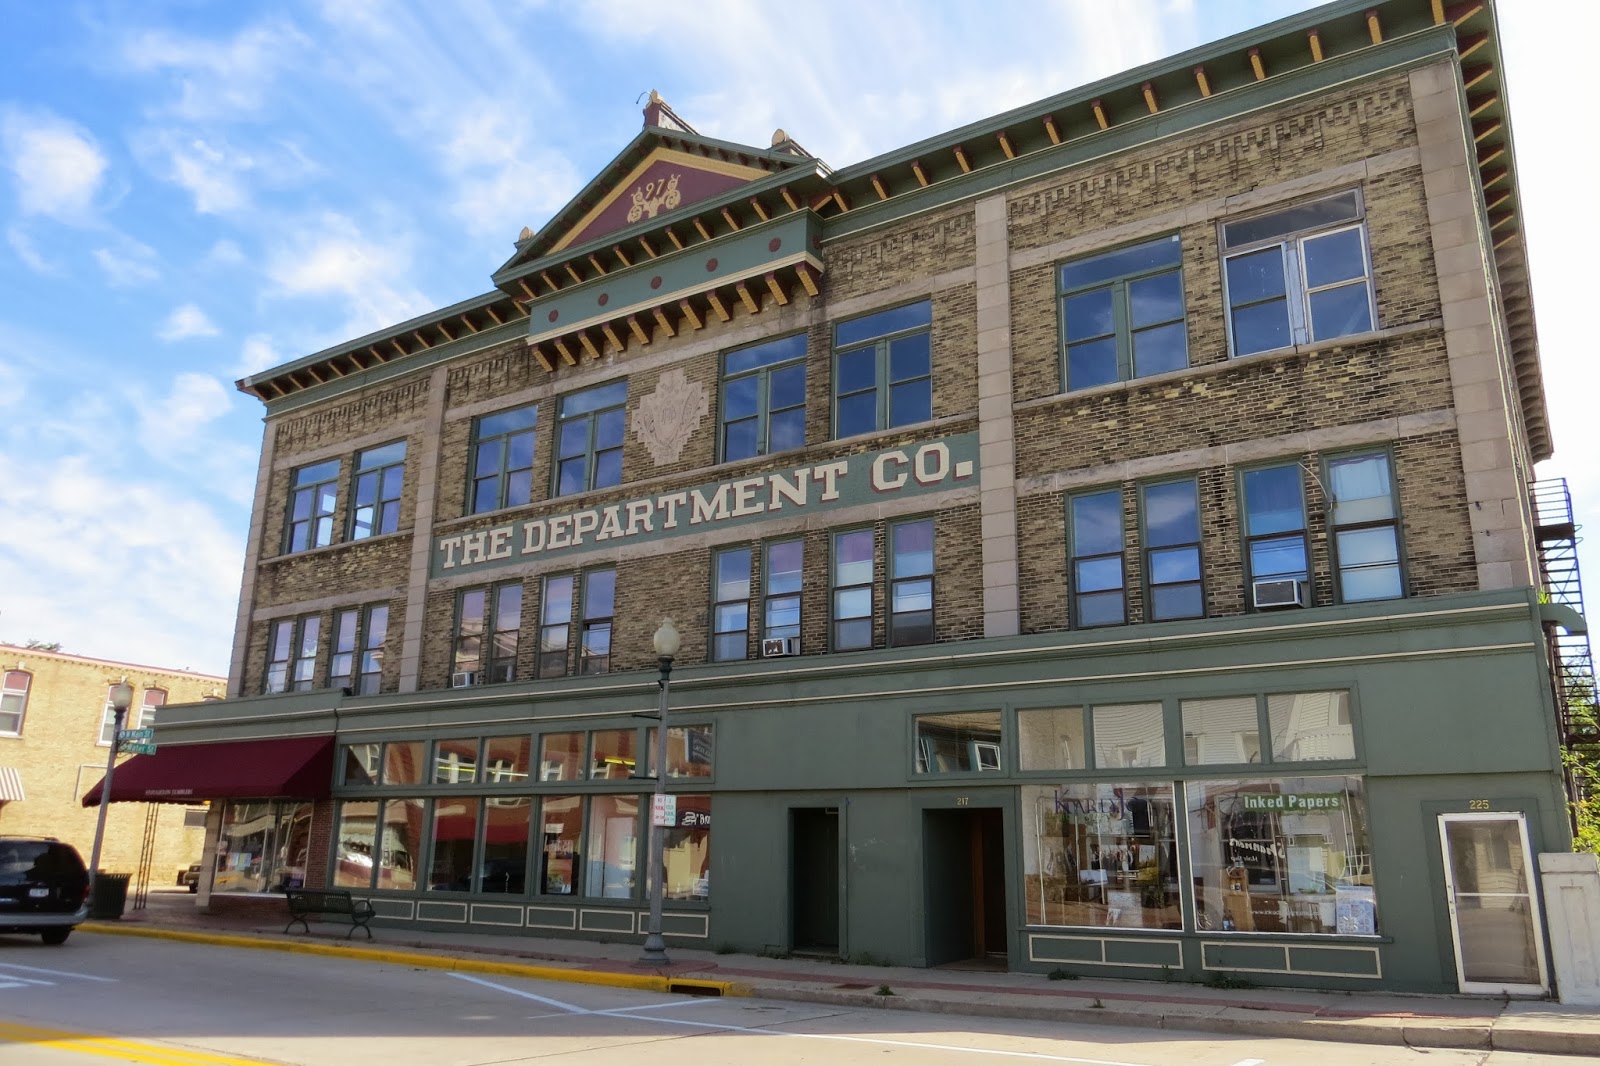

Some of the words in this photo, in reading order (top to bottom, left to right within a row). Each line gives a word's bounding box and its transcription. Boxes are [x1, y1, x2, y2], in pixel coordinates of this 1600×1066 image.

[440, 528, 512, 570] THE
[521, 461, 849, 555] DEPARTMENT
[871, 440, 974, 494] CO.
[957, 797, 969, 806] 217
[1244, 795, 1284, 808] Inked
[1288, 795, 1339, 810] Papers
[1469, 800, 1490, 810] 225
